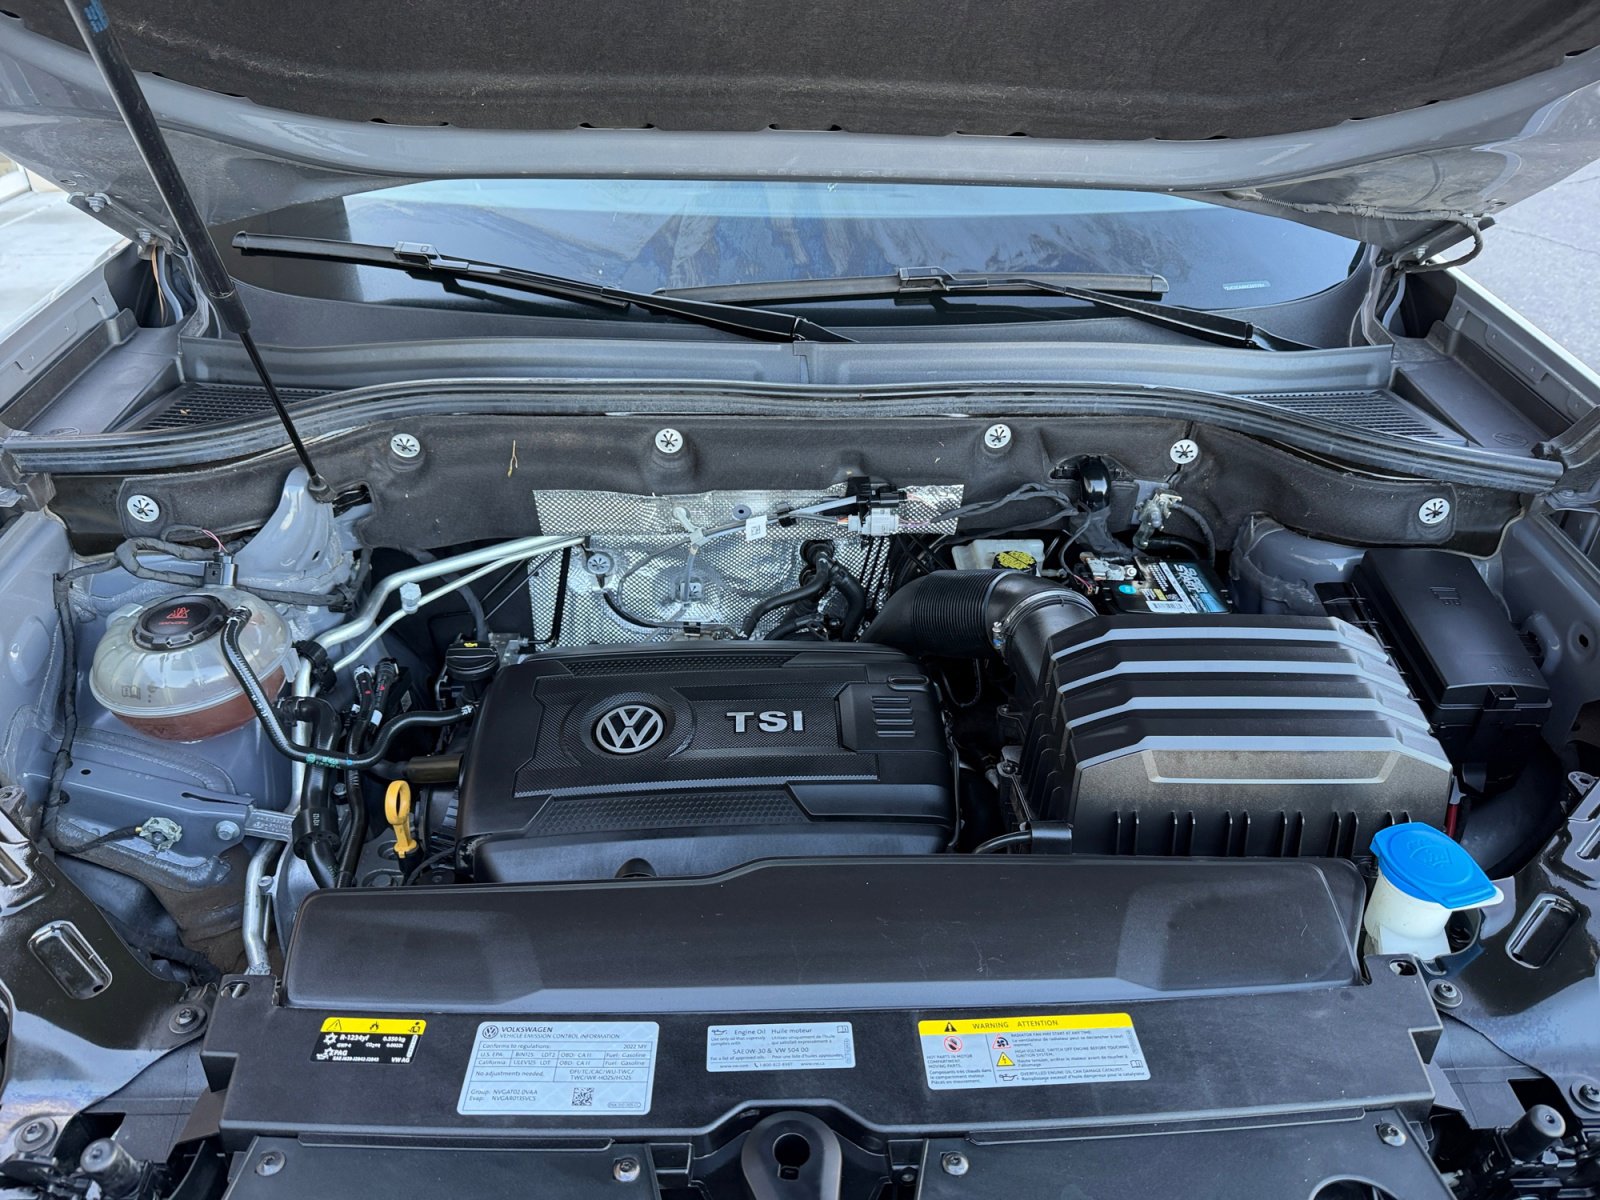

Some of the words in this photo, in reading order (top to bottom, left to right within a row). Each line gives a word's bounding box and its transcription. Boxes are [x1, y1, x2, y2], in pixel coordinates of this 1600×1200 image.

[596, 705, 664, 753] VW
[726, 710, 804, 733] TSI
[340, 1034, 370, 1042] R-1234yf
